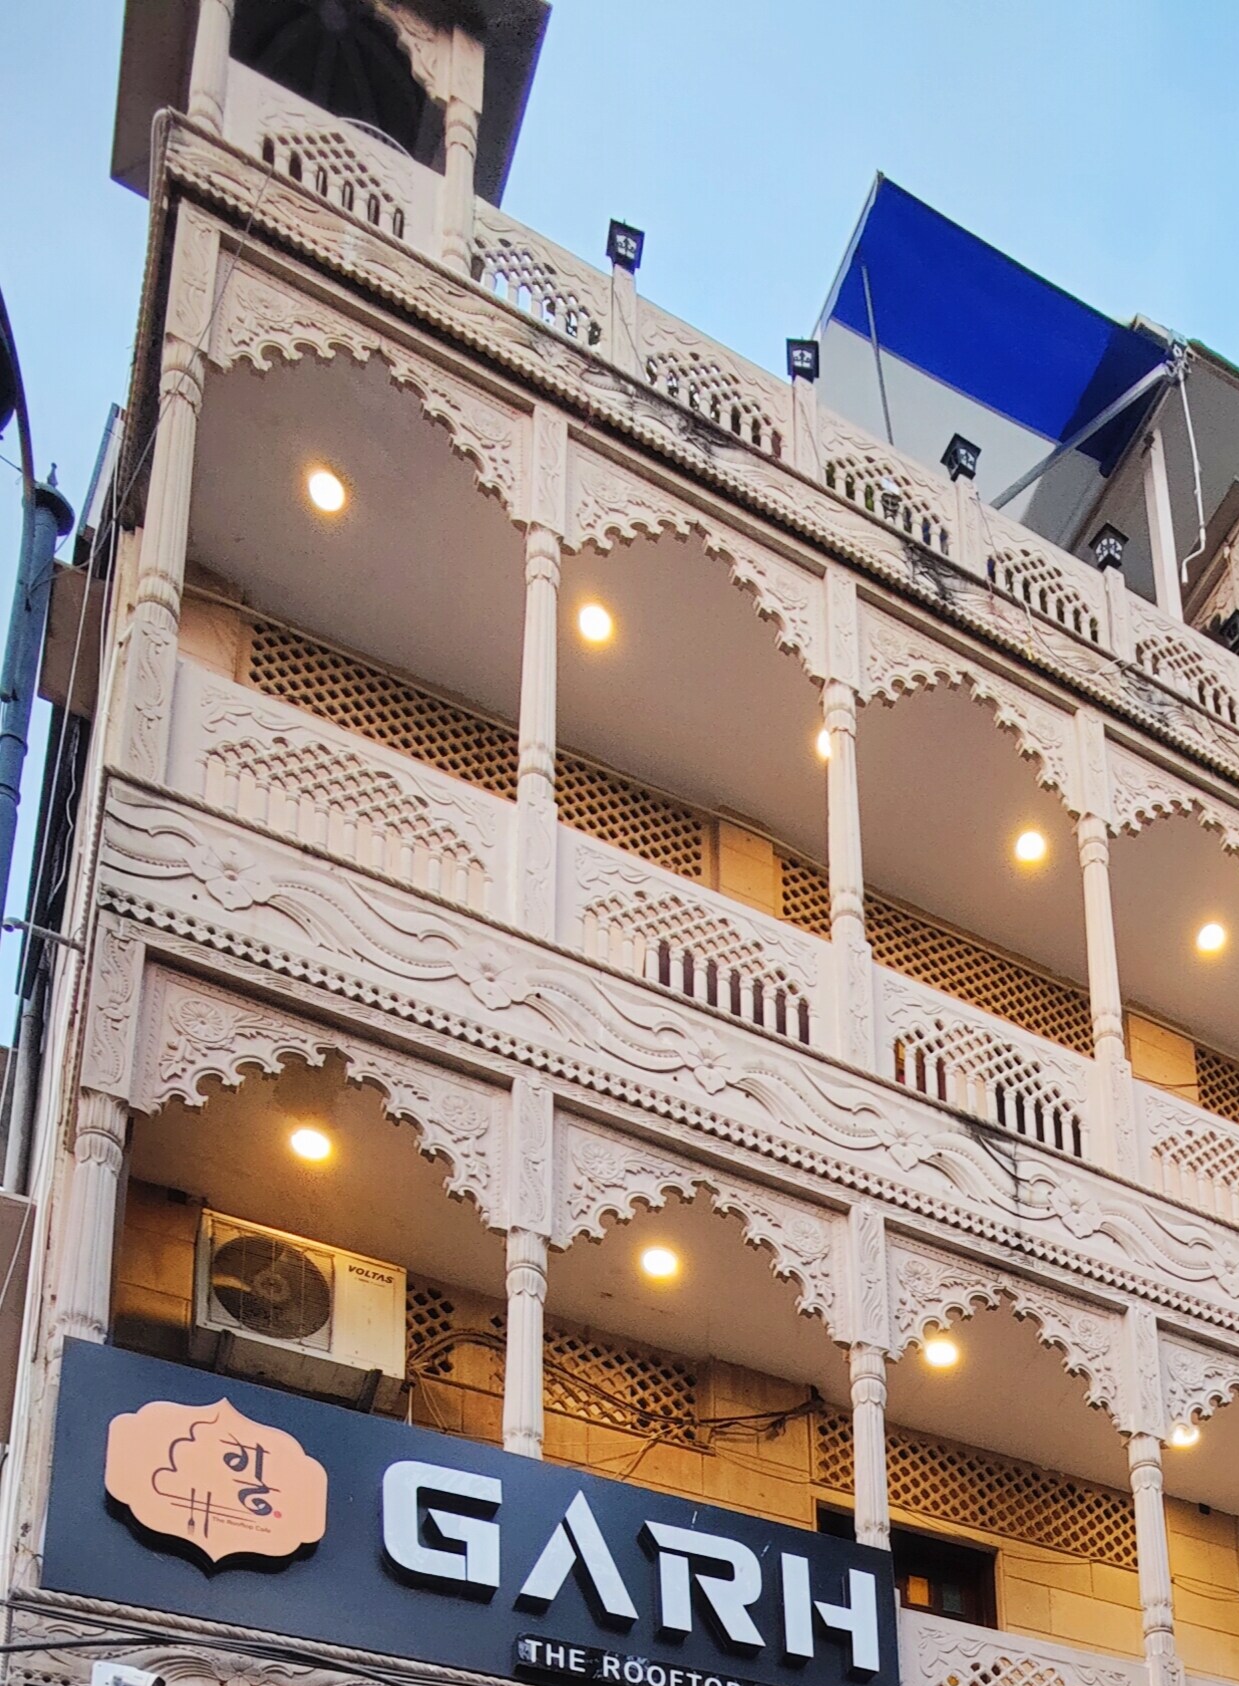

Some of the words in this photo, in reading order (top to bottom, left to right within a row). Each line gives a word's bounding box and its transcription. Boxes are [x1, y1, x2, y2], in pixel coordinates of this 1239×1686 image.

[348, 1265, 394, 1283] VOLTAS
[382, 1460, 880, 1673] GARH
[524, 1638, 586, 1673] THE
